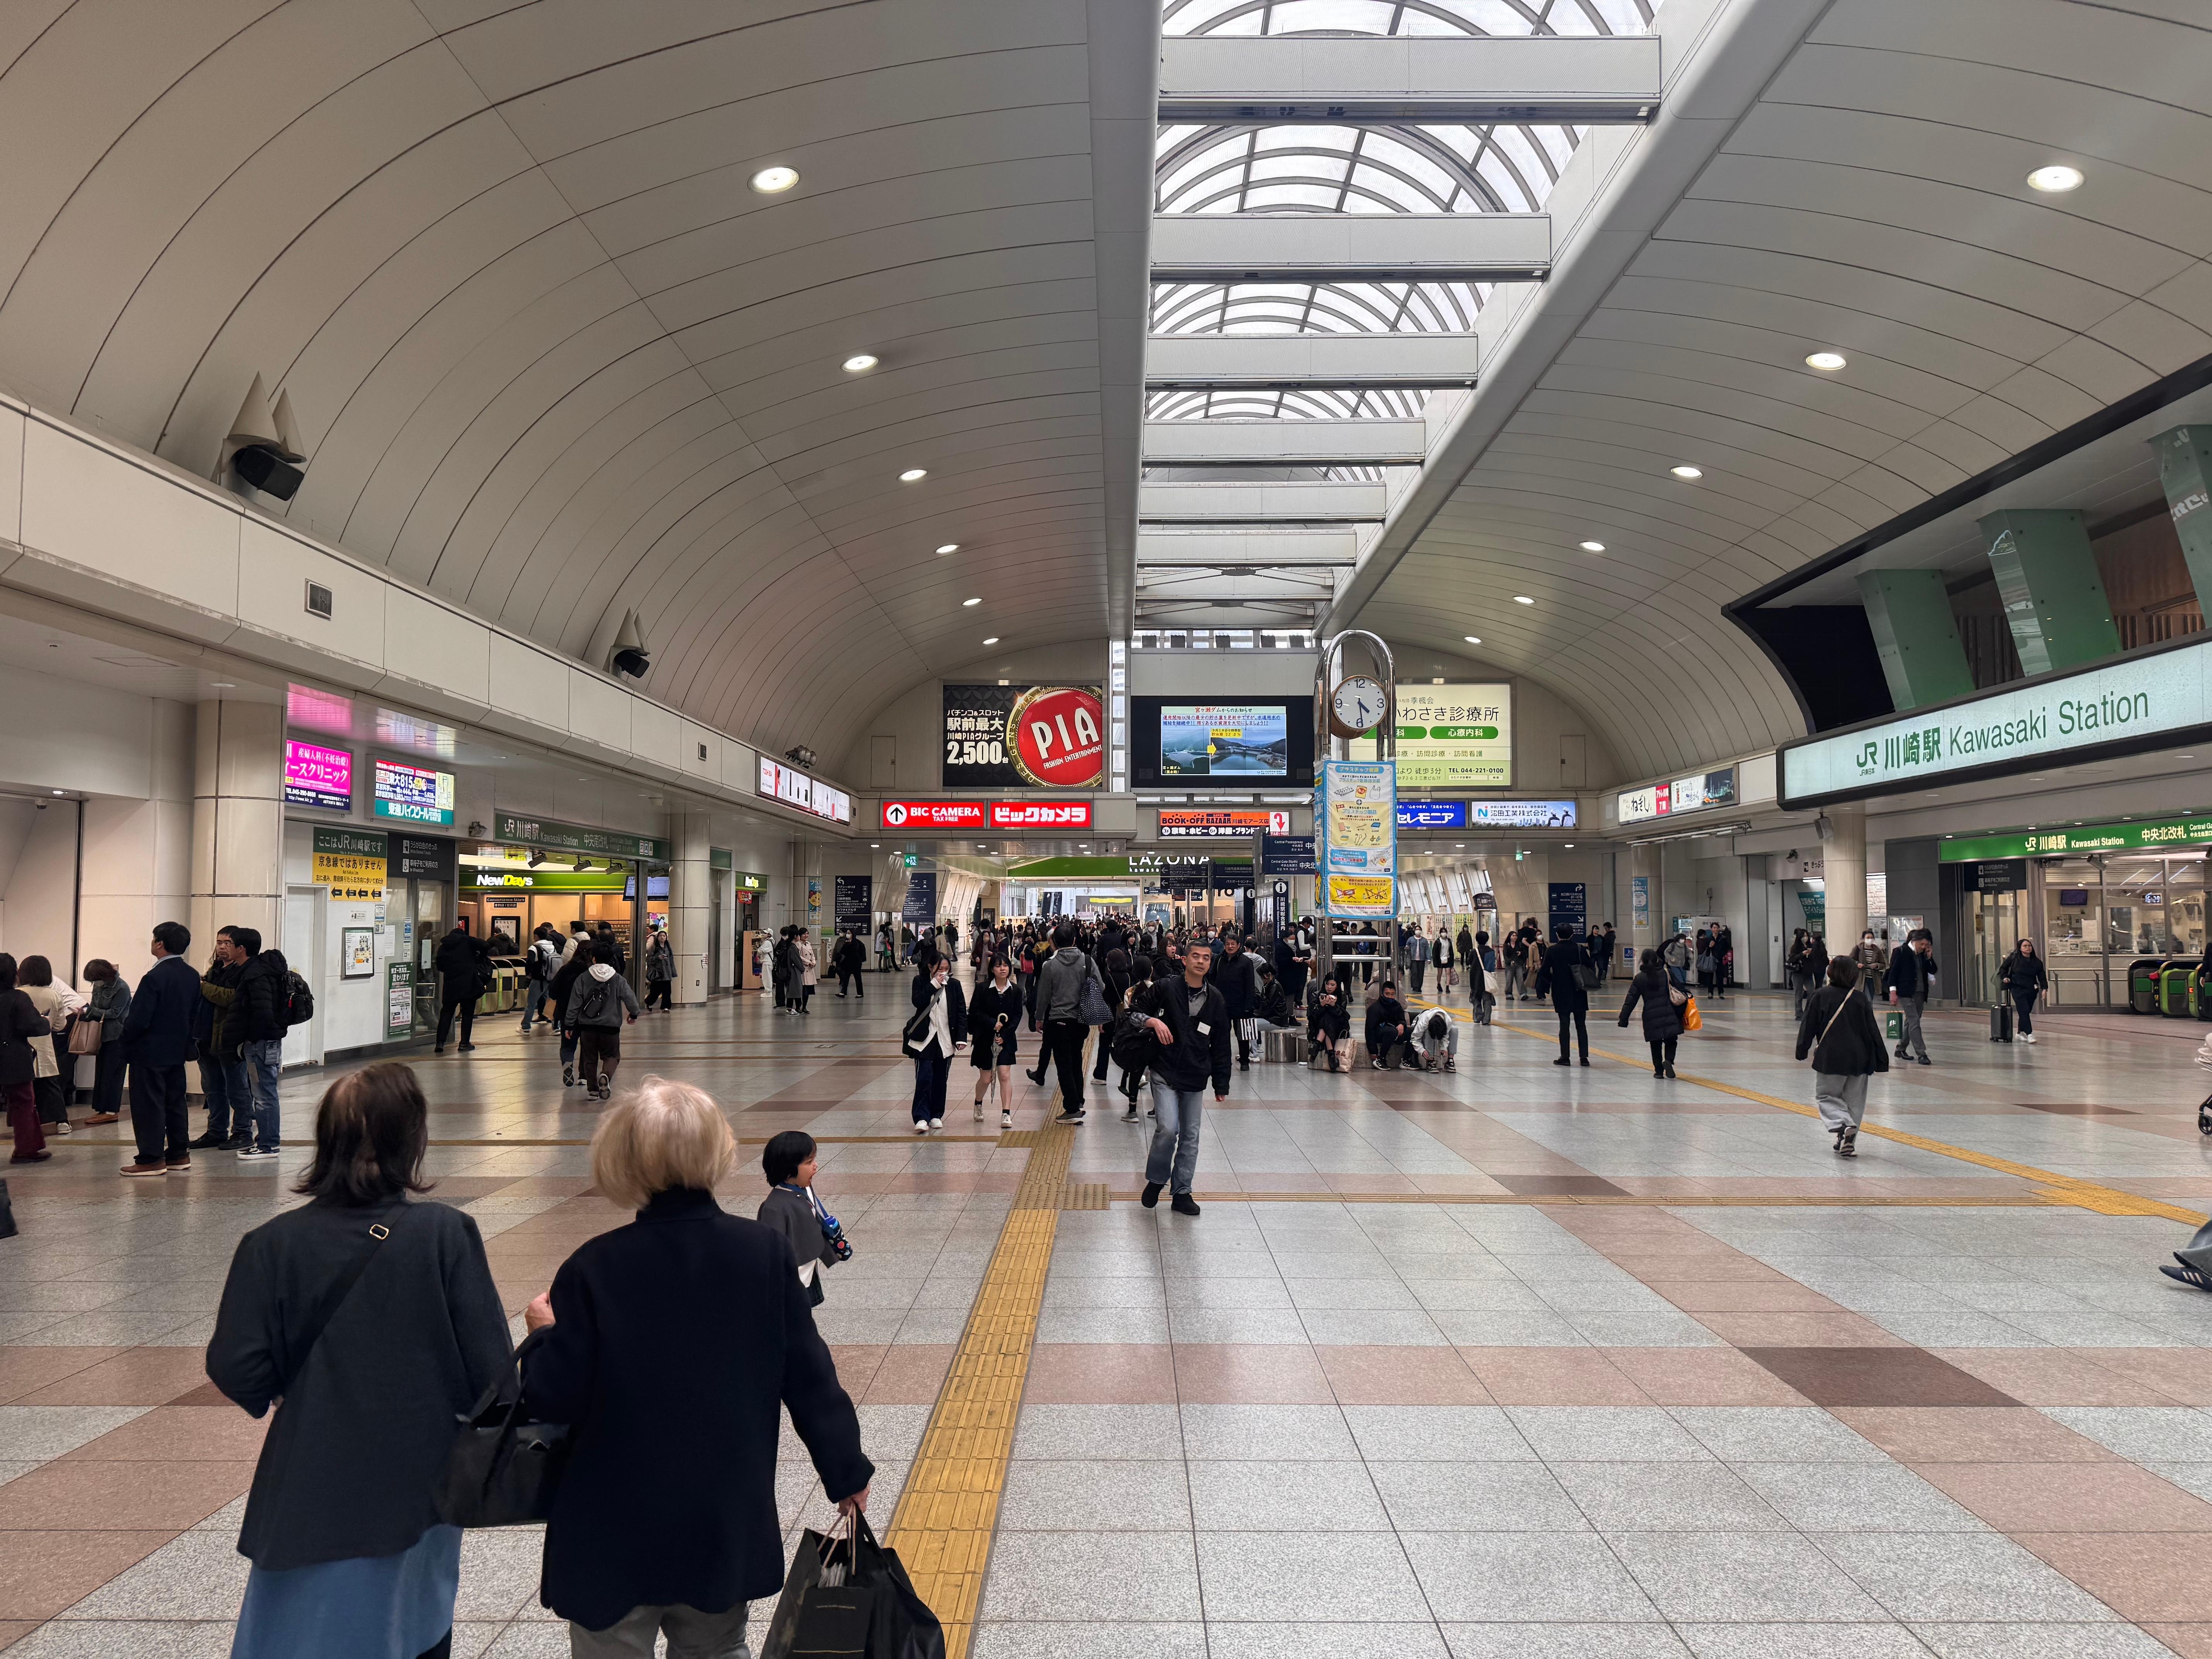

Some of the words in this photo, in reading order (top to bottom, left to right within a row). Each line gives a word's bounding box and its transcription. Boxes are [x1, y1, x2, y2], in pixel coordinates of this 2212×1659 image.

[1354, 679, 1365, 688] 12
[1335, 699, 1342, 708] 9
[1377, 699, 1384, 708] 3
[947, 717, 1004, 731] 駅前最大
[1356, 718, 1363, 728] 6
[1030, 707, 1099, 759] PIA
[1885, 727, 1941, 771] 川崎駅
[1950, 707, 2046, 756] Kawasaki
[2058, 691, 2148, 734] Station
[1043, 758, 1064, 769] FASHION
[1065, 745, 1102, 762] ENTERTAINMENT
[1856, 741, 1877, 768] JR
[388, 802, 429, 821] 東進ハイスクール
[910, 807, 929, 816] BIC
[932, 807, 980, 816] CAMERA
[995, 807, 1086, 822] ビックカメラ
[505, 819, 515, 833] JR
[517, 820, 539, 840] 川崎駅
[541, 831, 562, 844] Kawasaki
[563, 834, 578, 846] Station
[2142, 826, 2186, 841] 中央北改札
[2025, 837, 2036, 847] JR
[2039, 835, 2066, 850] 川崎駅
[2071, 838, 2100, 848] Kawasaki
[2101, 837, 2124, 846] Station
[319, 855, 382, 870] 京急線ではありません
[476, 874, 534, 887] NewDays
